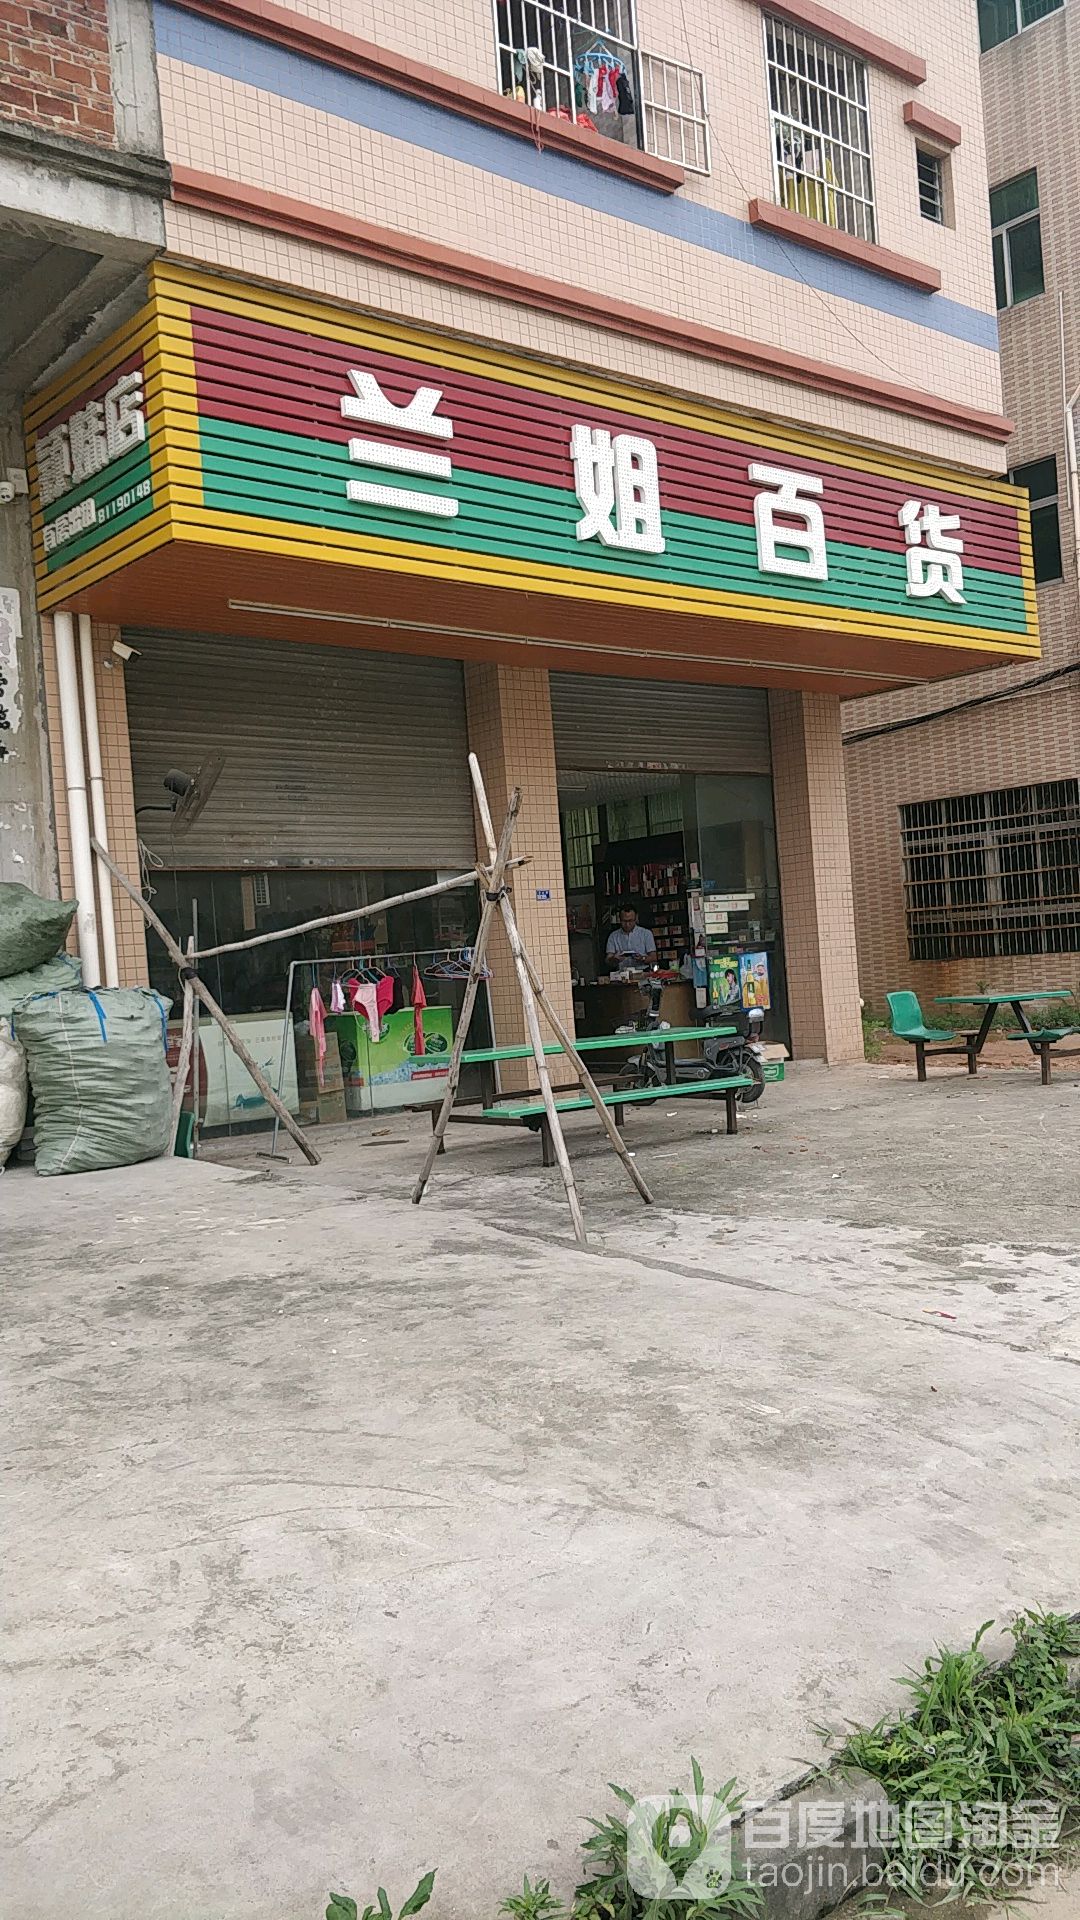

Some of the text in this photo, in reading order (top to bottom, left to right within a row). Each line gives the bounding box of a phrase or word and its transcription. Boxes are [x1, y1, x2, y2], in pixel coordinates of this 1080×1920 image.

[97, 479, 152, 524] 81190148
[340, 368, 967, 605] 兰姐百货
